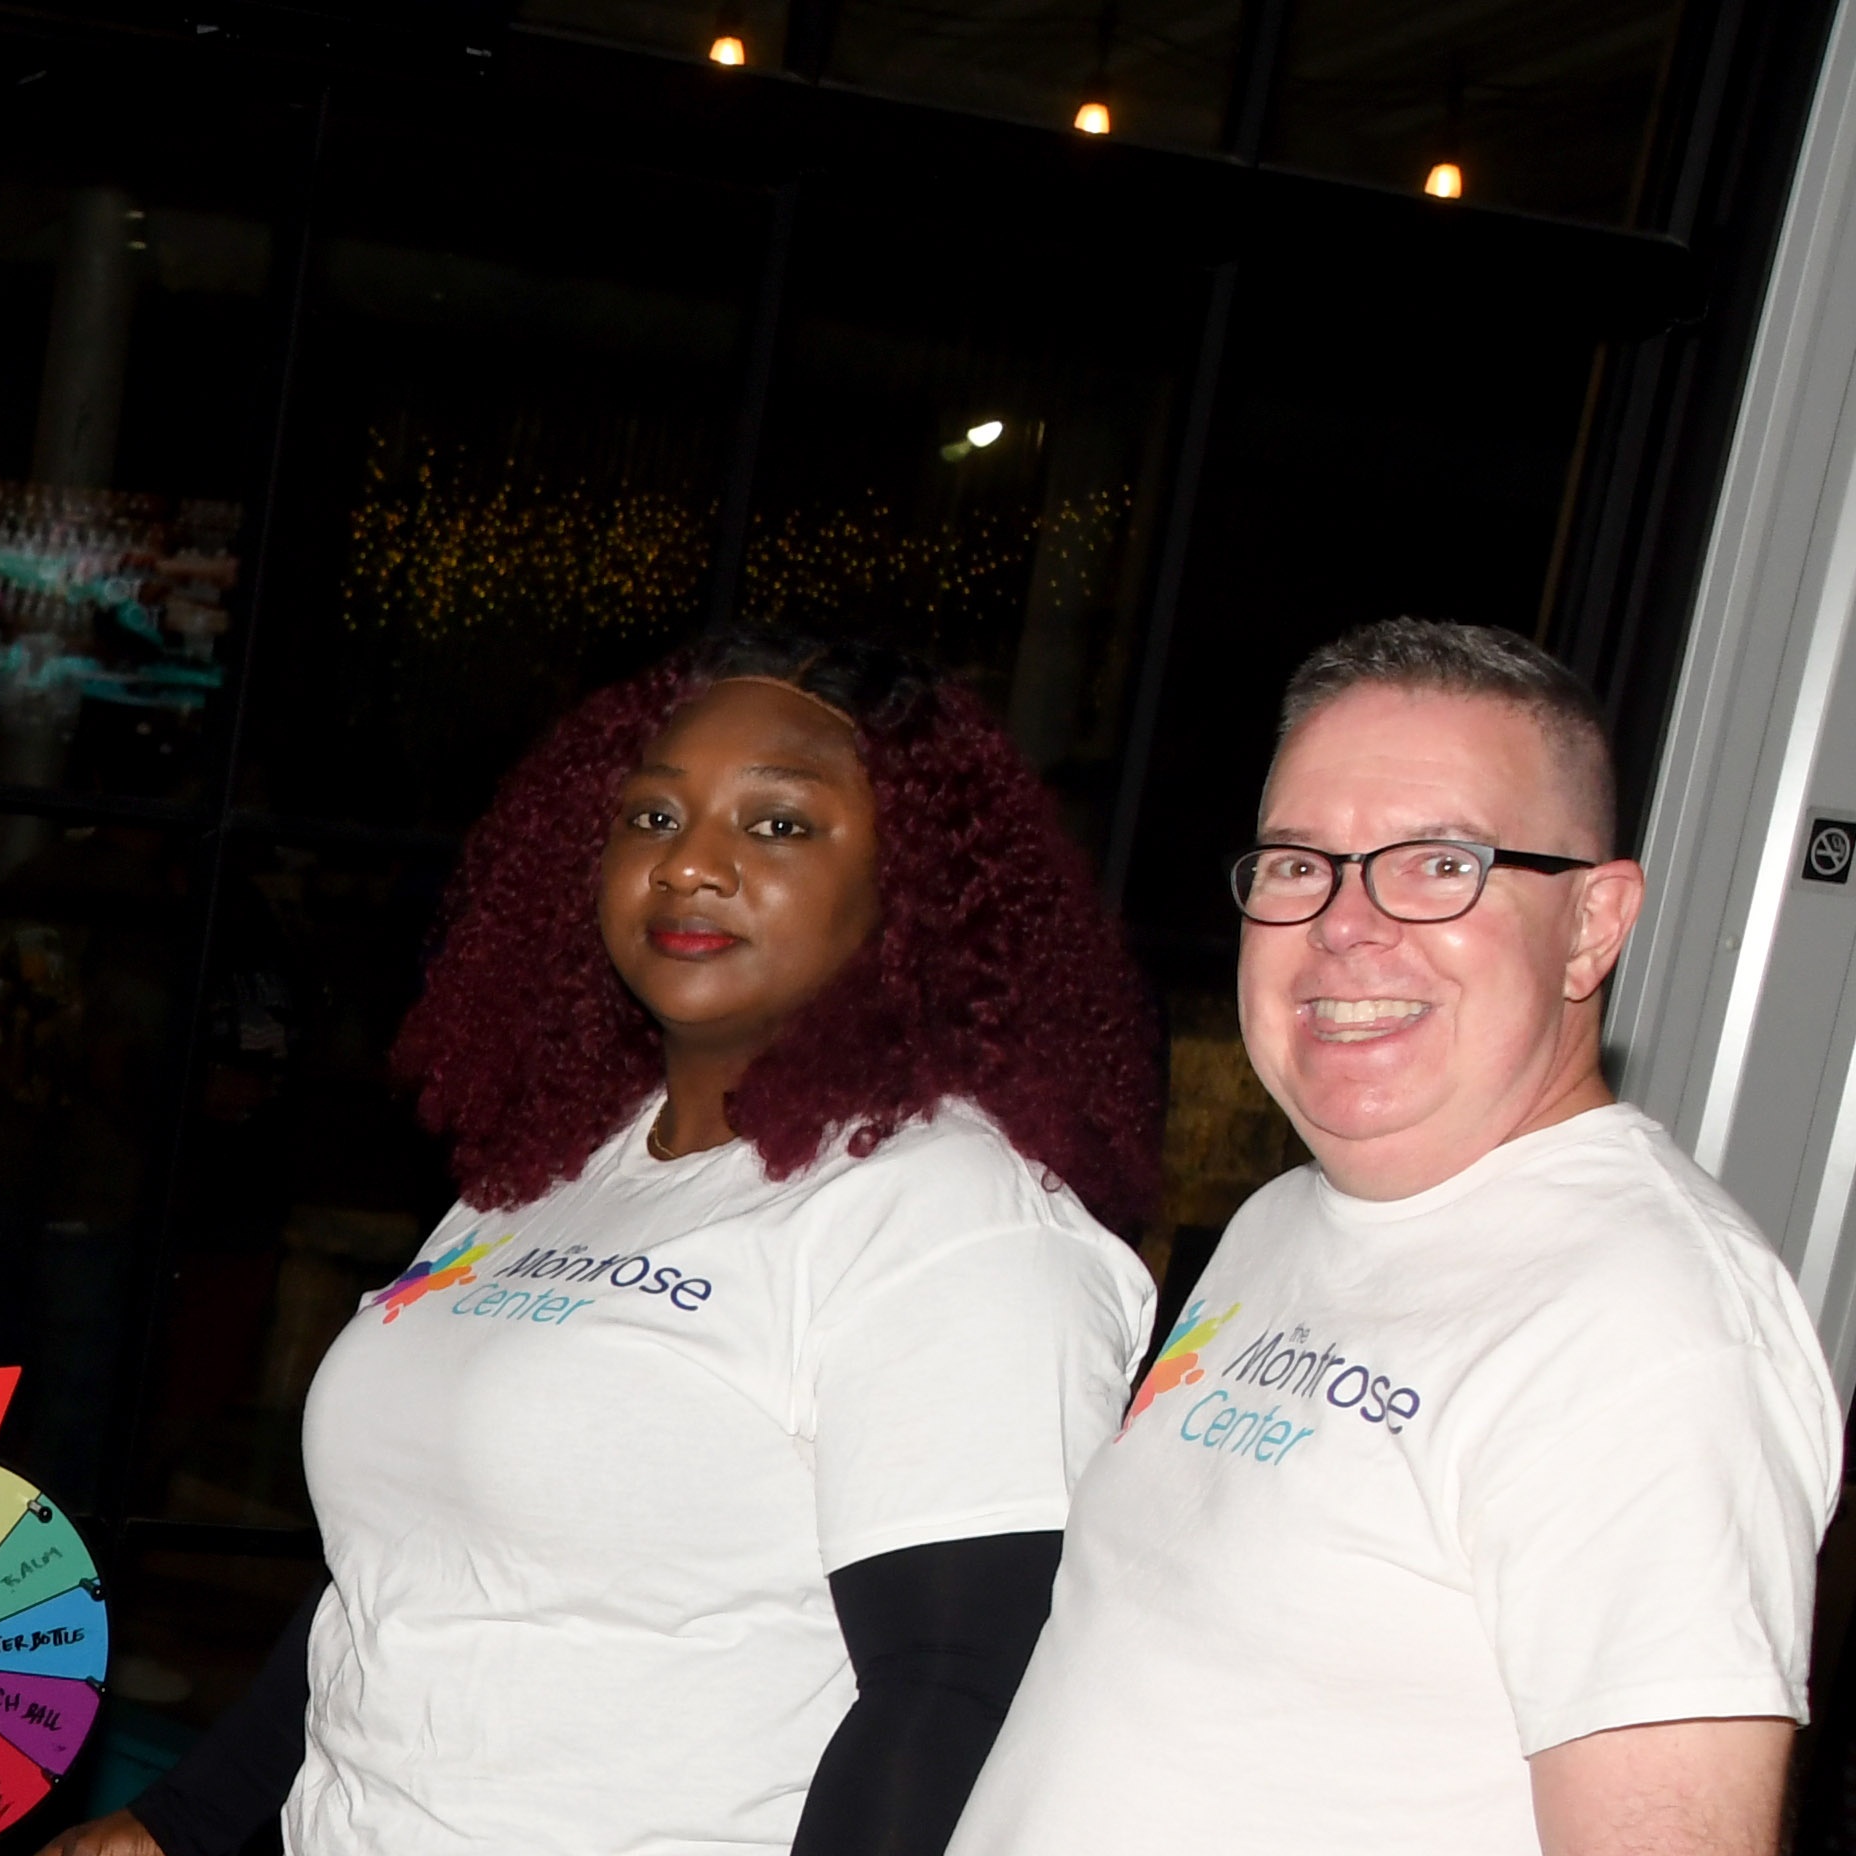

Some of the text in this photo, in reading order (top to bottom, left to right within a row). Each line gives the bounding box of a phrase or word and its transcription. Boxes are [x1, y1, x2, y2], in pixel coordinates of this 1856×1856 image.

[452, 1283, 595, 1326] Center
[1289, 1320, 1311, 1344] the
[1221, 1328, 1421, 1435] Montrose
[1180, 1389, 1315, 1466] Center
[28, 1626, 86, 1652] BOTTLE
[21, 1700, 63, 1732] BALL
